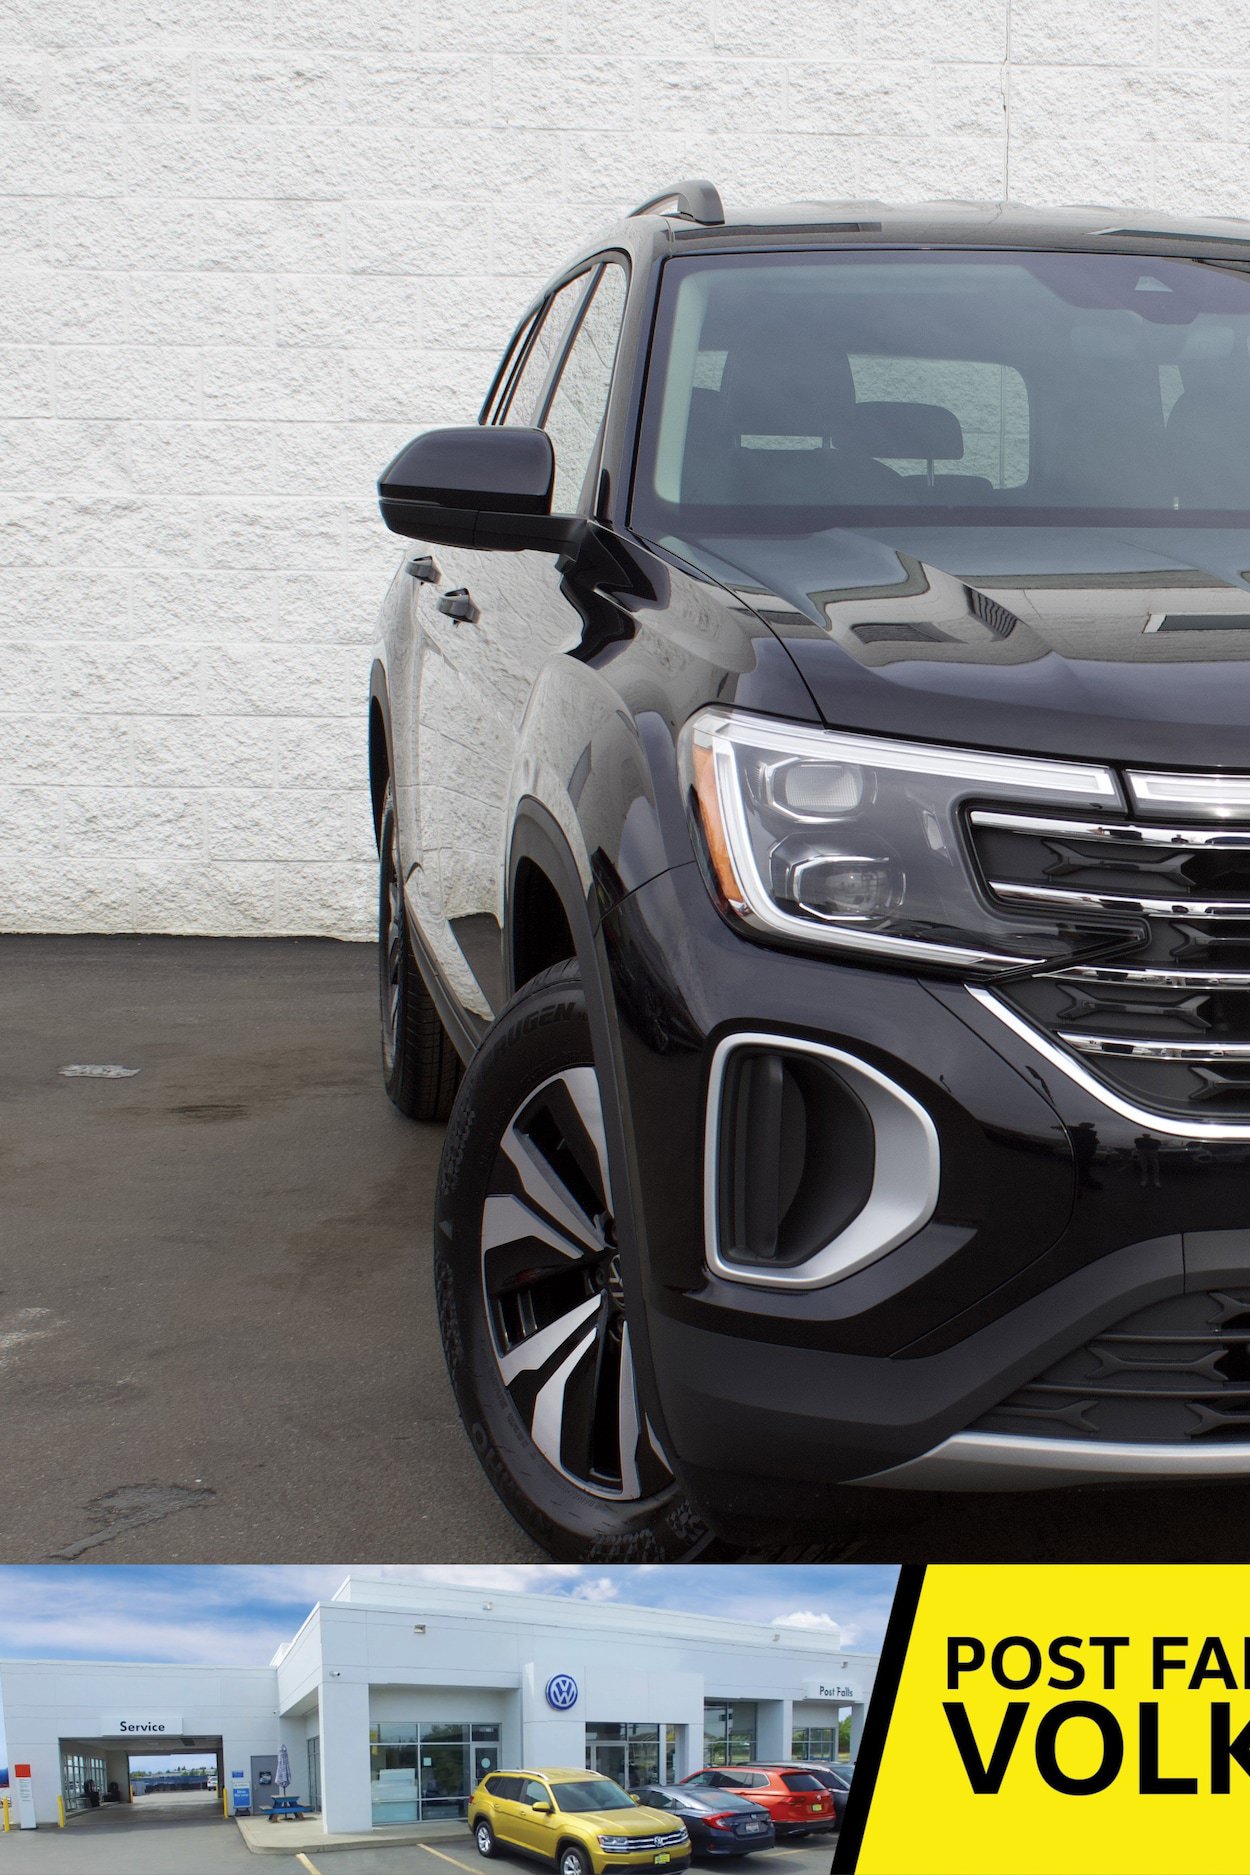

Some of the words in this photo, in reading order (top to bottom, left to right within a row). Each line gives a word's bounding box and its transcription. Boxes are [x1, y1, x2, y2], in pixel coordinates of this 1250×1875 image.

[819, 1685, 835, 1697] Post
[836, 1686, 853, 1697] Falls
[120, 1720, 165, 1732] Service
